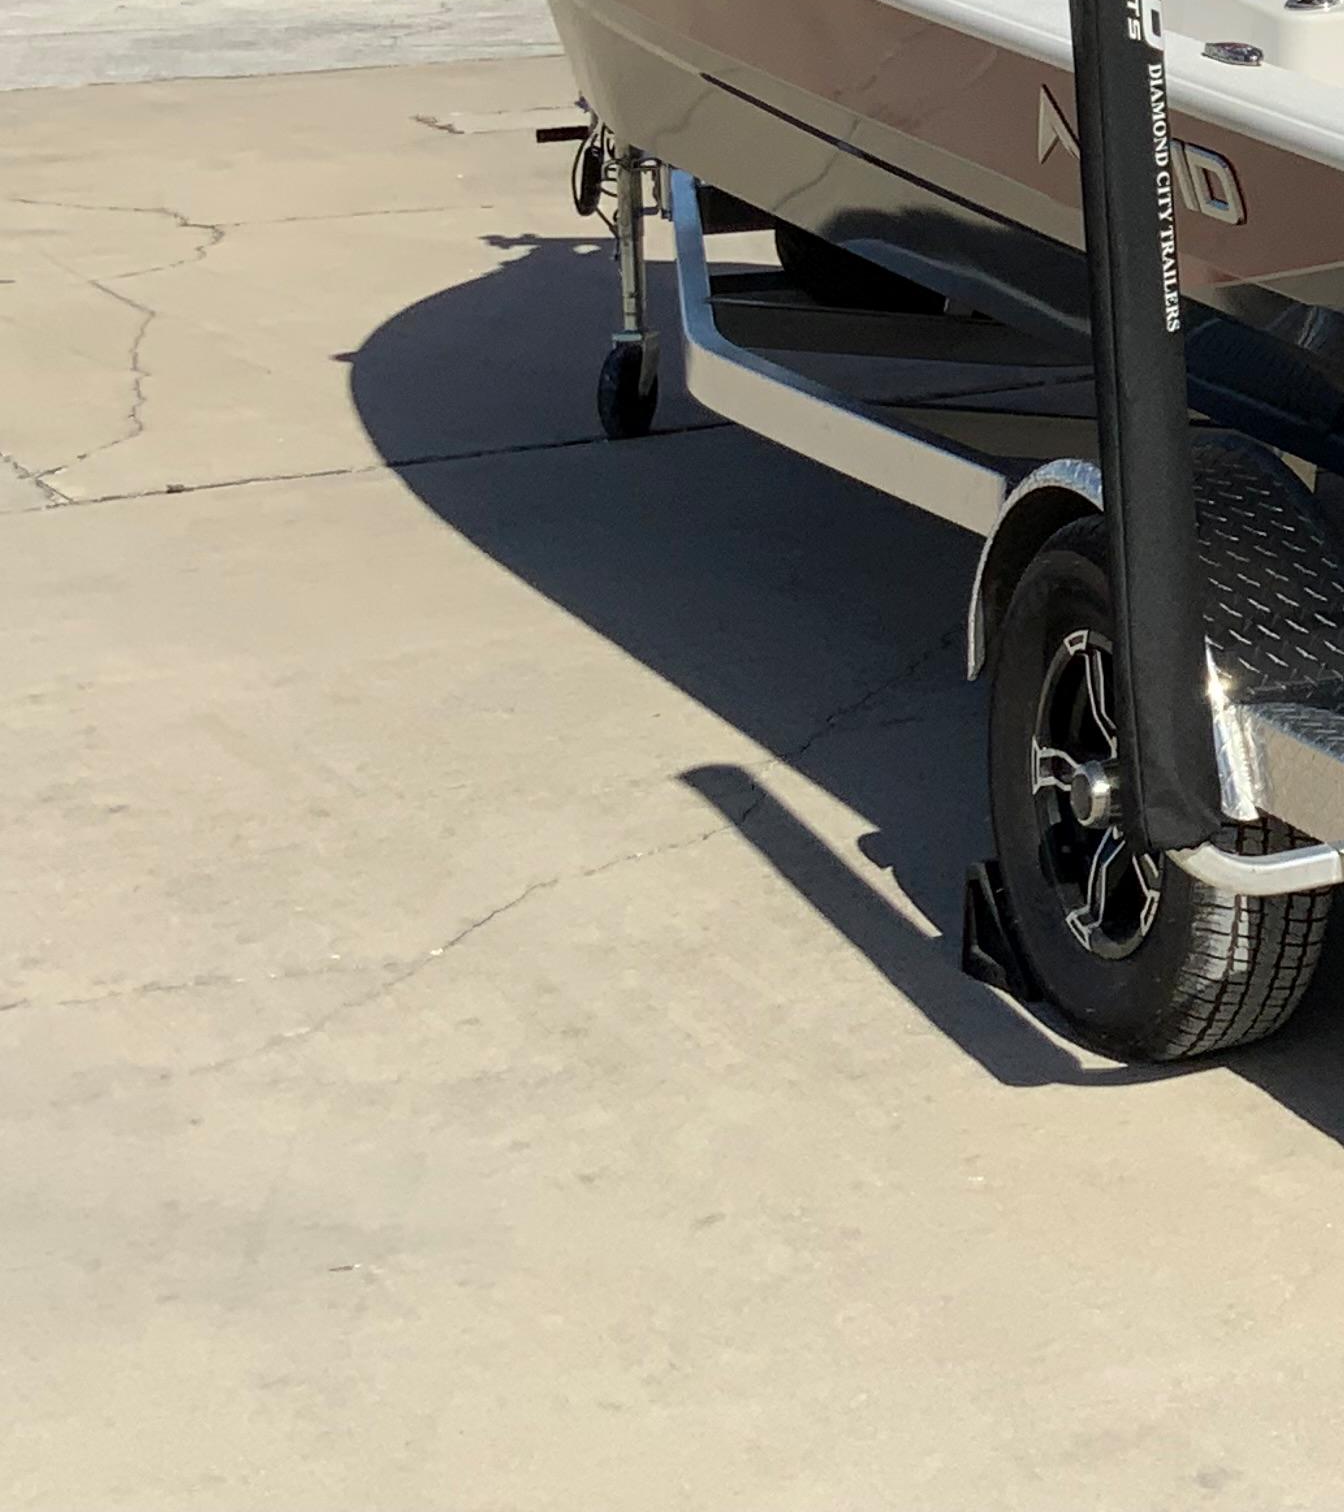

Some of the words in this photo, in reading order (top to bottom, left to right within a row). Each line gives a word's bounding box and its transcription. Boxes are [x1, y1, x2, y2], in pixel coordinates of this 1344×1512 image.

[1148, 63, 1170, 168] DIAMOND
[1155, 170, 1174, 222] CITY
[1158, 224, 1181, 333] TRAILERS
